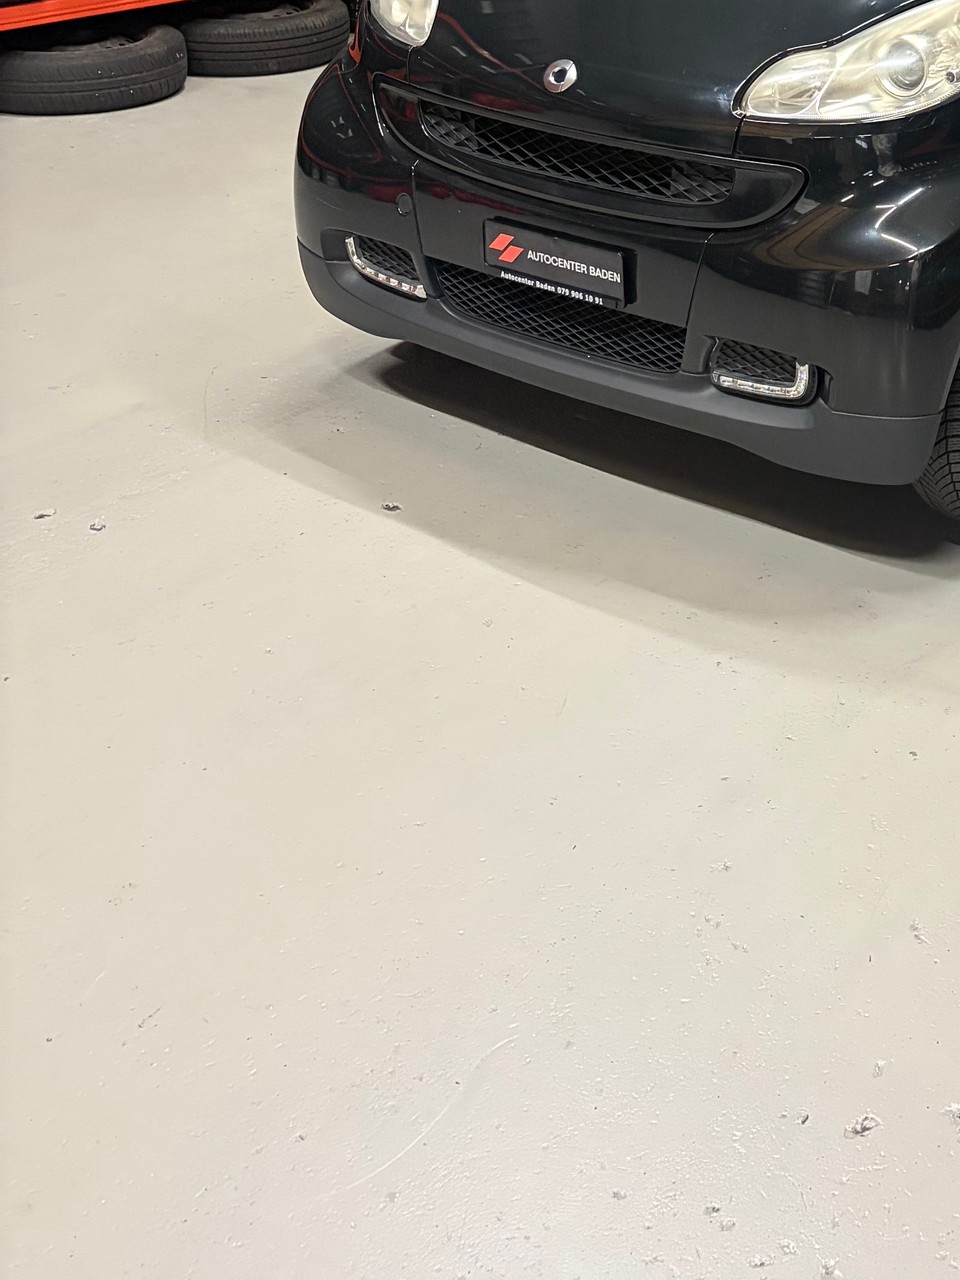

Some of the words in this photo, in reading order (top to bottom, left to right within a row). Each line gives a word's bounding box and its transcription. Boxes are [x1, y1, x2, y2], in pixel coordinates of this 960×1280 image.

[527, 250, 587, 274] AUTOCENTER
[589, 266, 621, 283] BADEN
[500, 270, 534, 286] Autocenter
[535, 280, 556, 292] Baden
[557, 286, 569, 297] 079
[570, 290, 583, 300] 906
[585, 294, 593, 303] 10
[594, 296, 604, 305] 91
